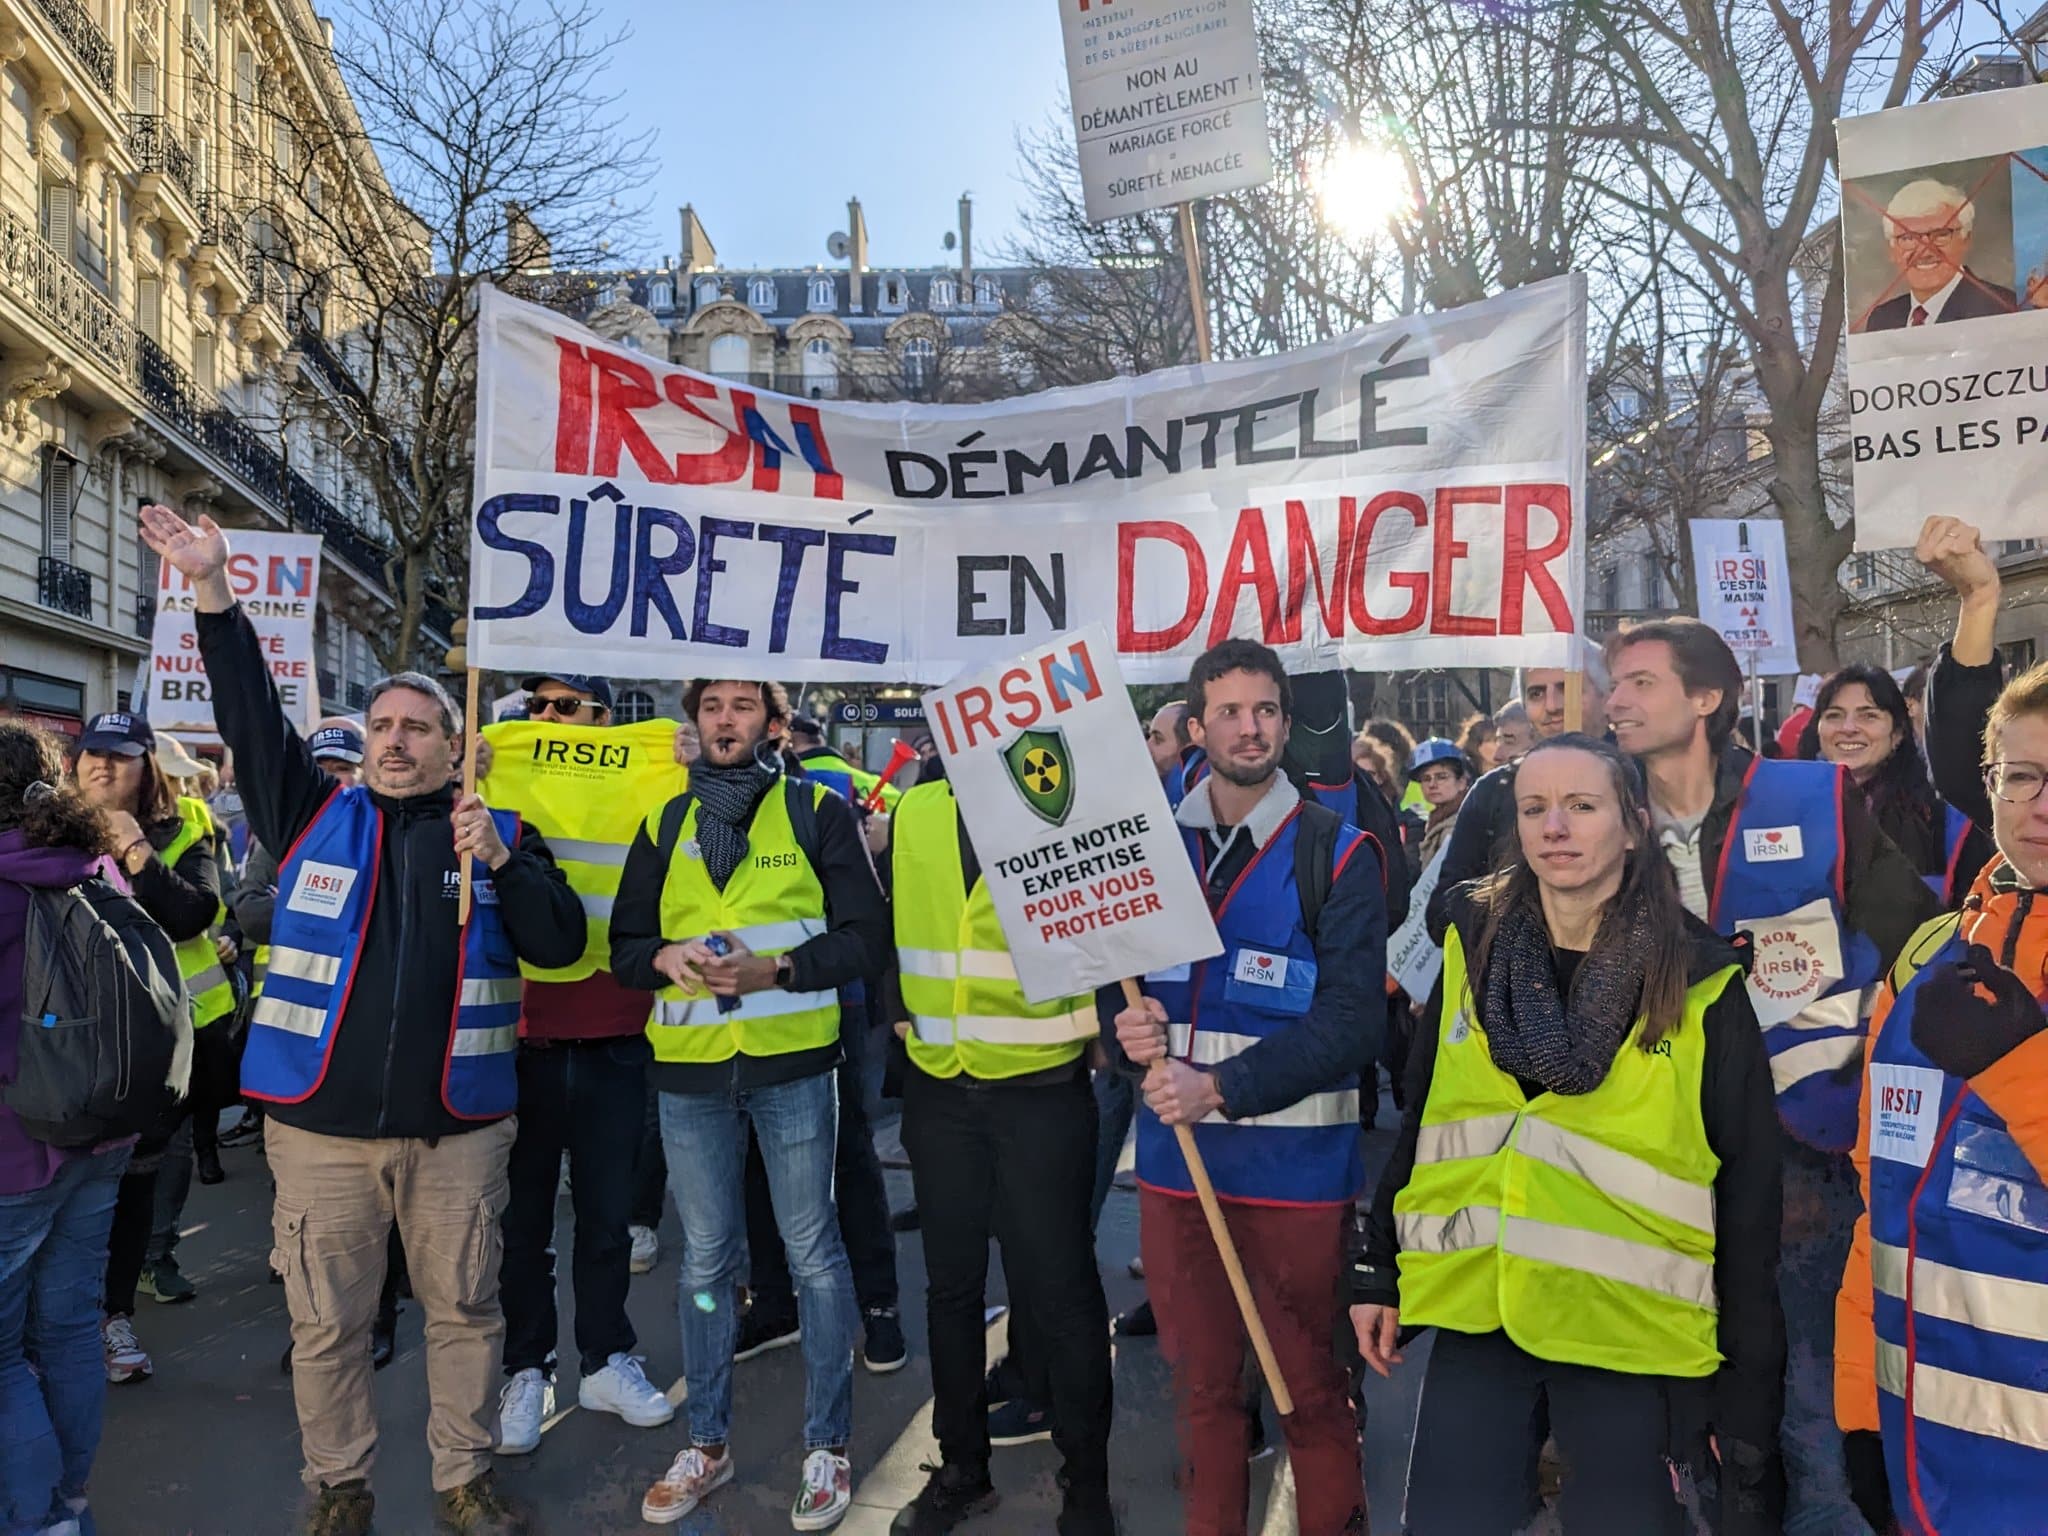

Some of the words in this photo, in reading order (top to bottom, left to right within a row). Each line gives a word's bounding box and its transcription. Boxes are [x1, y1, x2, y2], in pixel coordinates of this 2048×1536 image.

[1127, 66, 1167, 92] NON
[1173, 57, 1198, 80] AU
[1081, 76, 1240, 132] DÉMANTÈLEMENT
[1108, 126, 1177, 156] MARIAGE
[1181, 110, 1233, 139] FORCÉ
[1107, 168, 1166, 199] SÛRETÉ
[1170, 152, 1243, 185] MENACÉE
[555, 336, 843, 499] IRSN
[886, 334, 1430, 499] DÉMANTELÉ
[1853, 429, 1921, 462] BAS
[1935, 419, 2001, 453] LES
[160, 553, 313, 597] ISN
[474, 481, 896, 664] SÛRETÉ
[957, 552, 1066, 637] EN
[1116, 483, 1575, 654] DANGER
[934, 640, 1103, 755] IRSN
[532, 738, 630, 769] IRSN
[755, 853, 797, 869] IRSN
[995, 841, 1068, 879] TOUTE
[1071, 813, 1150, 854] NOTRE
[1752, 843, 1789, 857] IRSN
[1022, 842, 1146, 897] EXPERTISE
[1023, 889, 1086, 923] POUR
[1088, 867, 1155, 902] VOUS
[1040, 892, 1163, 944] PROTÉGER
[1243, 965, 1274, 982] IRSN
[1881, 1086, 1923, 1115] IRSN
